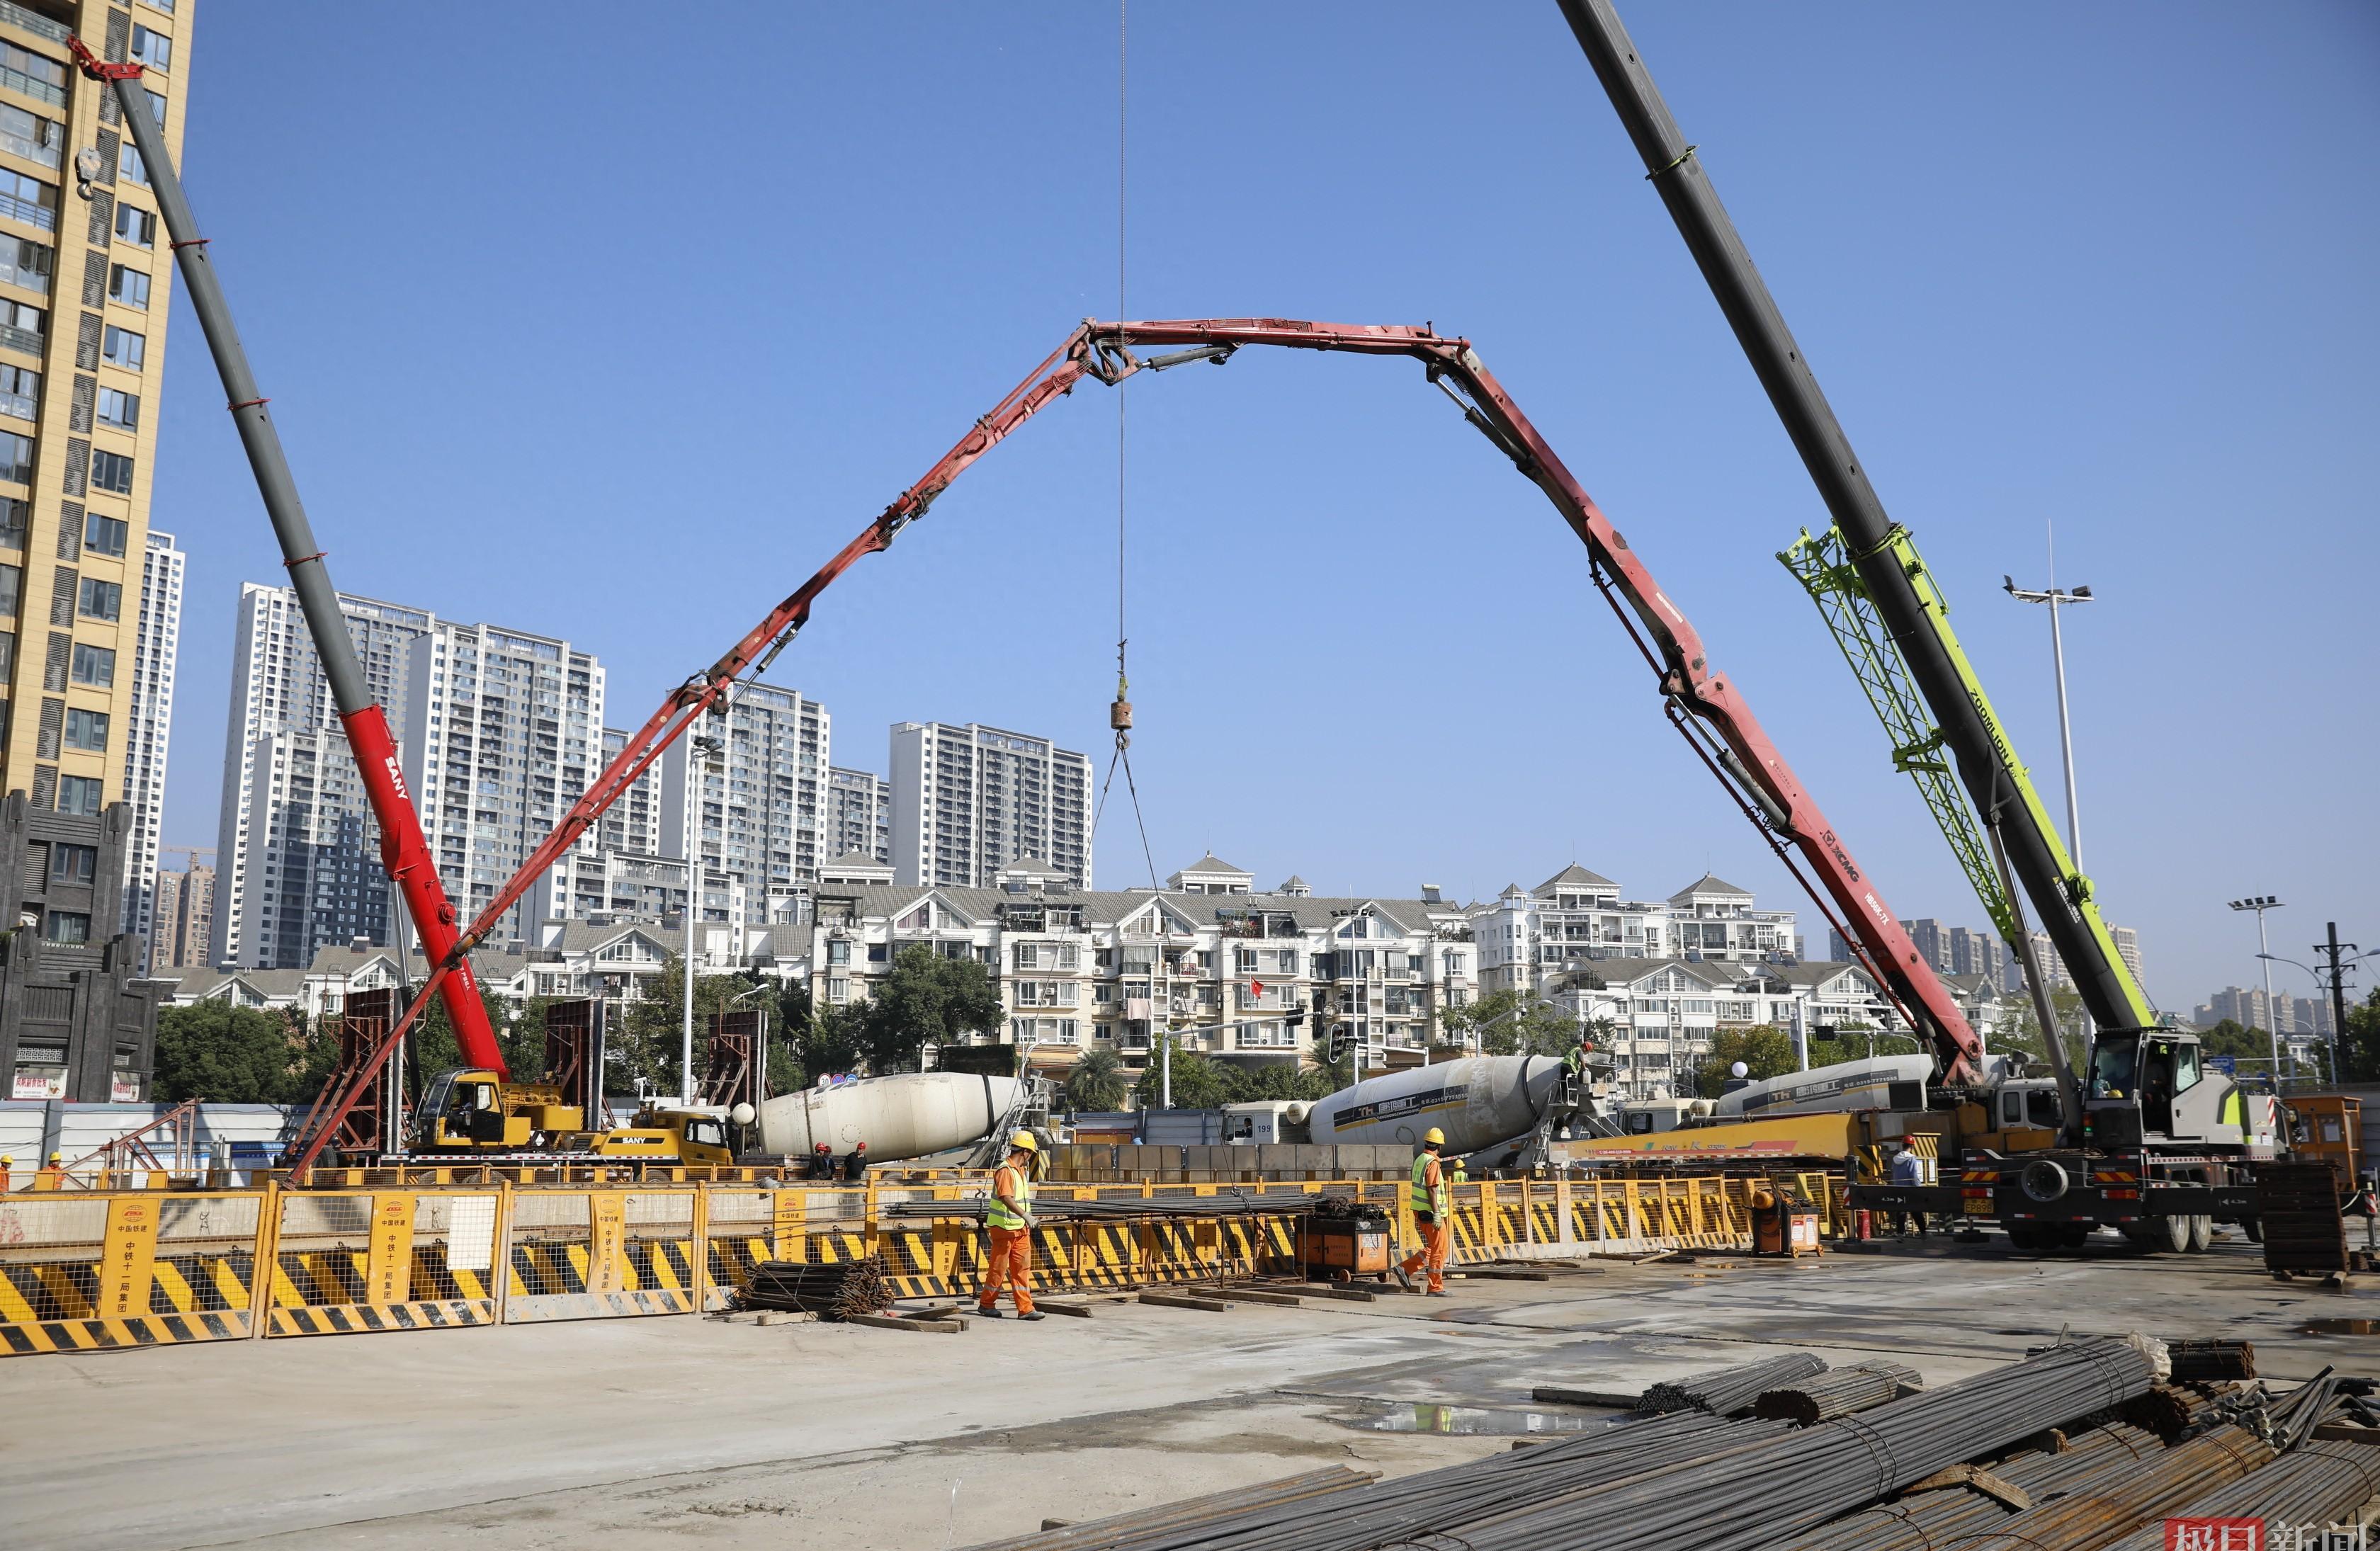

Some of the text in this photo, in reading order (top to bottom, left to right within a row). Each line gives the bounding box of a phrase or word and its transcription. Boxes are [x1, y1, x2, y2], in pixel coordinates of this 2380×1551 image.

[1969, 688, 2009, 761] ZOOMLION
[385, 756, 408, 800] SANY
[1832, 846, 1860, 883] XCMG
[118, 1241, 135, 1312] 中铁十一局集团
[383, 1234, 396, 1299] 中铁十一局集团
[601, 1229, 611, 1288] 中铁十一局集团
